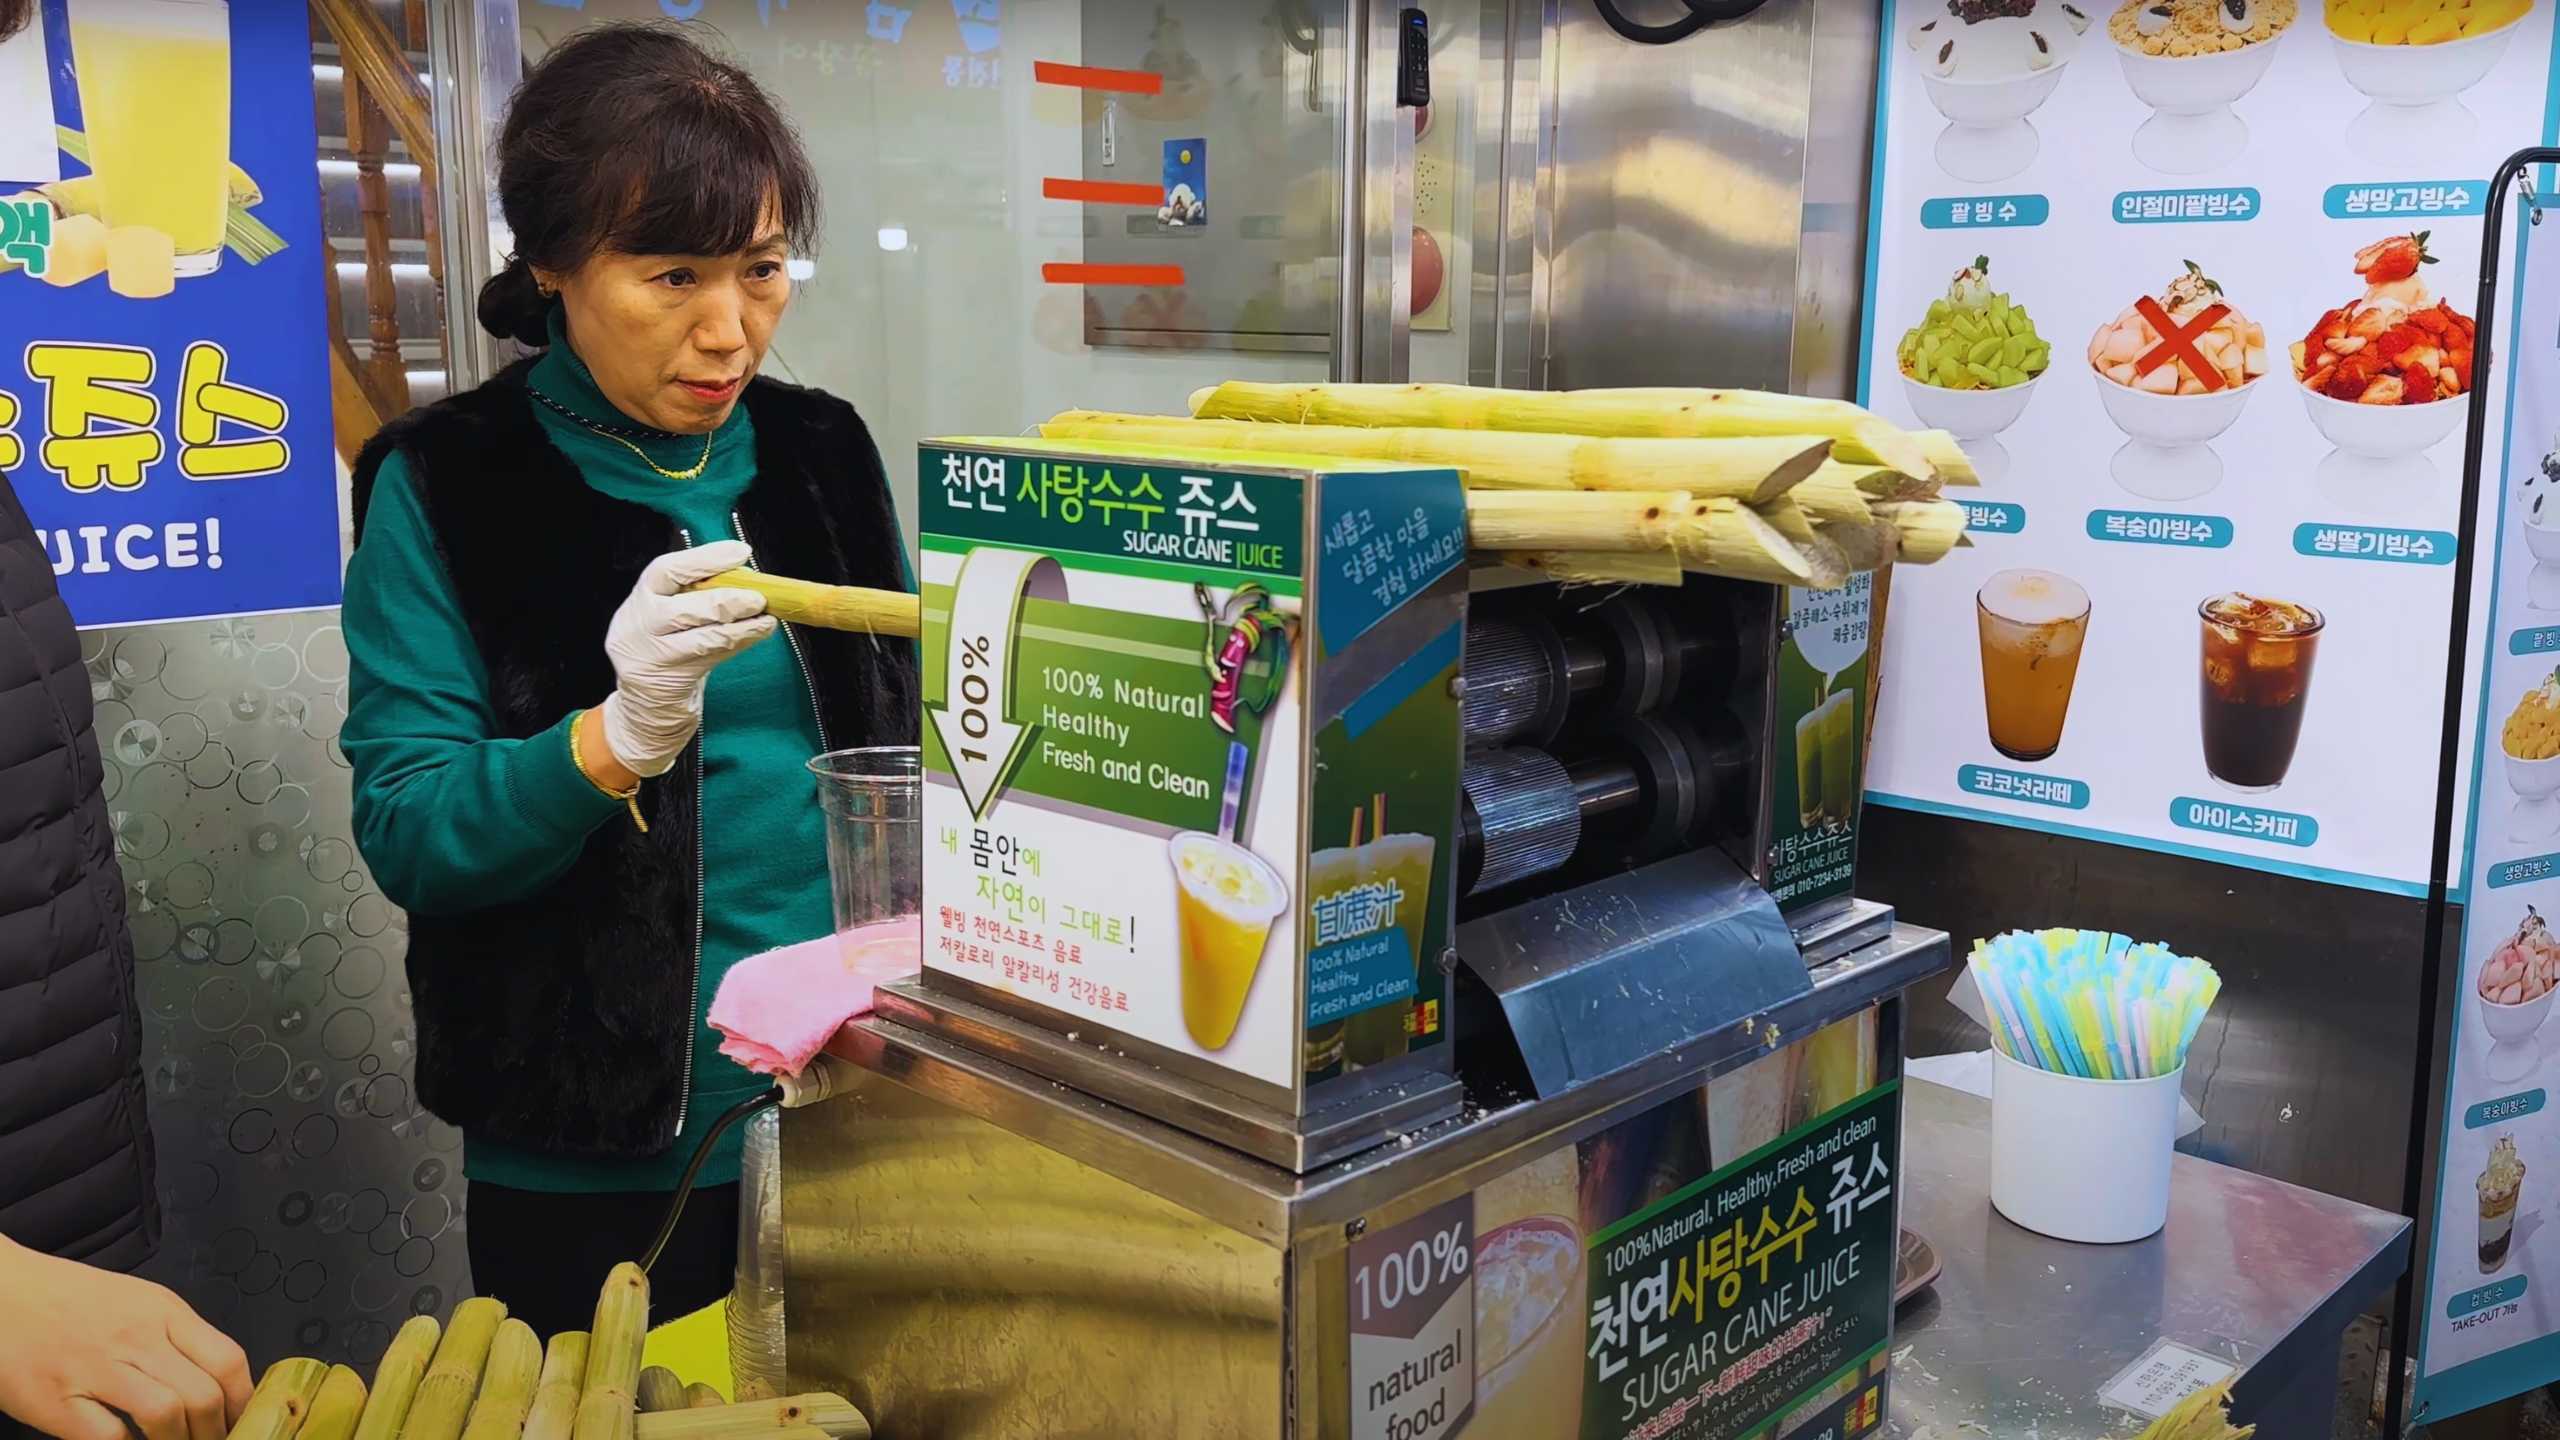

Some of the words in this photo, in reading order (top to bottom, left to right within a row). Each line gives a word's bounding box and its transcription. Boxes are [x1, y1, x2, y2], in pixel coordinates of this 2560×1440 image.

[2120, 191, 2251, 220] 인절미팥빙수
[2344, 186, 2471, 214] 생망고빙수
[0, 341, 290, 493] 쥬스
[941, 453, 1007, 513] 천연
[1016, 461, 1166, 531] 사탕수수
[1175, 474, 1260, 537] 쥬스
[35, 517, 222, 576] UICE!
[1123, 529, 1181, 558] SUGAR
[1183, 536, 1233, 564] CANE
[1236, 542, 1285, 571] JUICE
[1324, 509, 1375, 555] 새롭고
[1342, 533, 1395, 585] 달콤한
[1396, 507, 1430, 548] 맛을
[2105, 514, 2213, 542] 복숭아빙수
[2313, 530, 2435, 560] 생딸기빙수
[2534, 631, 2560, 648] 팥빙
[960, 635, 990, 763] 100%
[1042, 666, 1104, 700] 100%
[1114, 678, 1204, 719] Natural
[1043, 703, 1130, 748] Healthy
[1043, 741, 1095, 775] Fresh
[1102, 759, 1142, 784] and
[1148, 763, 1210, 800] Clean
[1974, 771, 2072, 805] 코코넛라떼
[2188, 805, 2298, 842] 아이스커피
[941, 825, 958, 856] 내
[970, 828, 1041, 877] 몸안에
[1774, 863, 1801, 884] SUGAR
[1802, 855, 1825, 873] CANE
[1826, 847, 1849, 865] JUICE
[2504, 859, 2552, 881] 생망고빙수
[976, 875, 1045, 925] 자연이
[1311, 878, 1405, 946] 甘蔗汁
[973, 916, 1046, 951] 천연스포츠
[1053, 939, 1083, 965] 음료
[1311, 949, 1343, 973] 100%
[1345, 935, 1389, 965] Natural
[940, 936, 995, 968] 저칼로리
[1002, 955, 1060, 994] 알칼리성
[1069, 976, 1129, 1012] 건강음료
[1311, 970, 1360, 994] Healthy
[1310, 994, 1348, 1019] Fresh
[1349, 985, 1374, 1006] and
[1375, 979, 1409, 998] Clean
[1816, 1128, 1841, 1162] and
[1843, 1115, 1877, 1147] clean
[1826, 1141, 1891, 1235] 쥬스
[1355, 1221, 1469, 1320] 100%
[1621, 1330, 1717, 1422] SUGAR
[1724, 1282, 1793, 1355] CANE
[1797, 1240, 1861, 1313] JUICE
[2451, 1307, 2501, 1333] TAKE-OUT
[1368, 1328, 1462, 1412] natural
[1386, 1385, 1446, 1440] food
